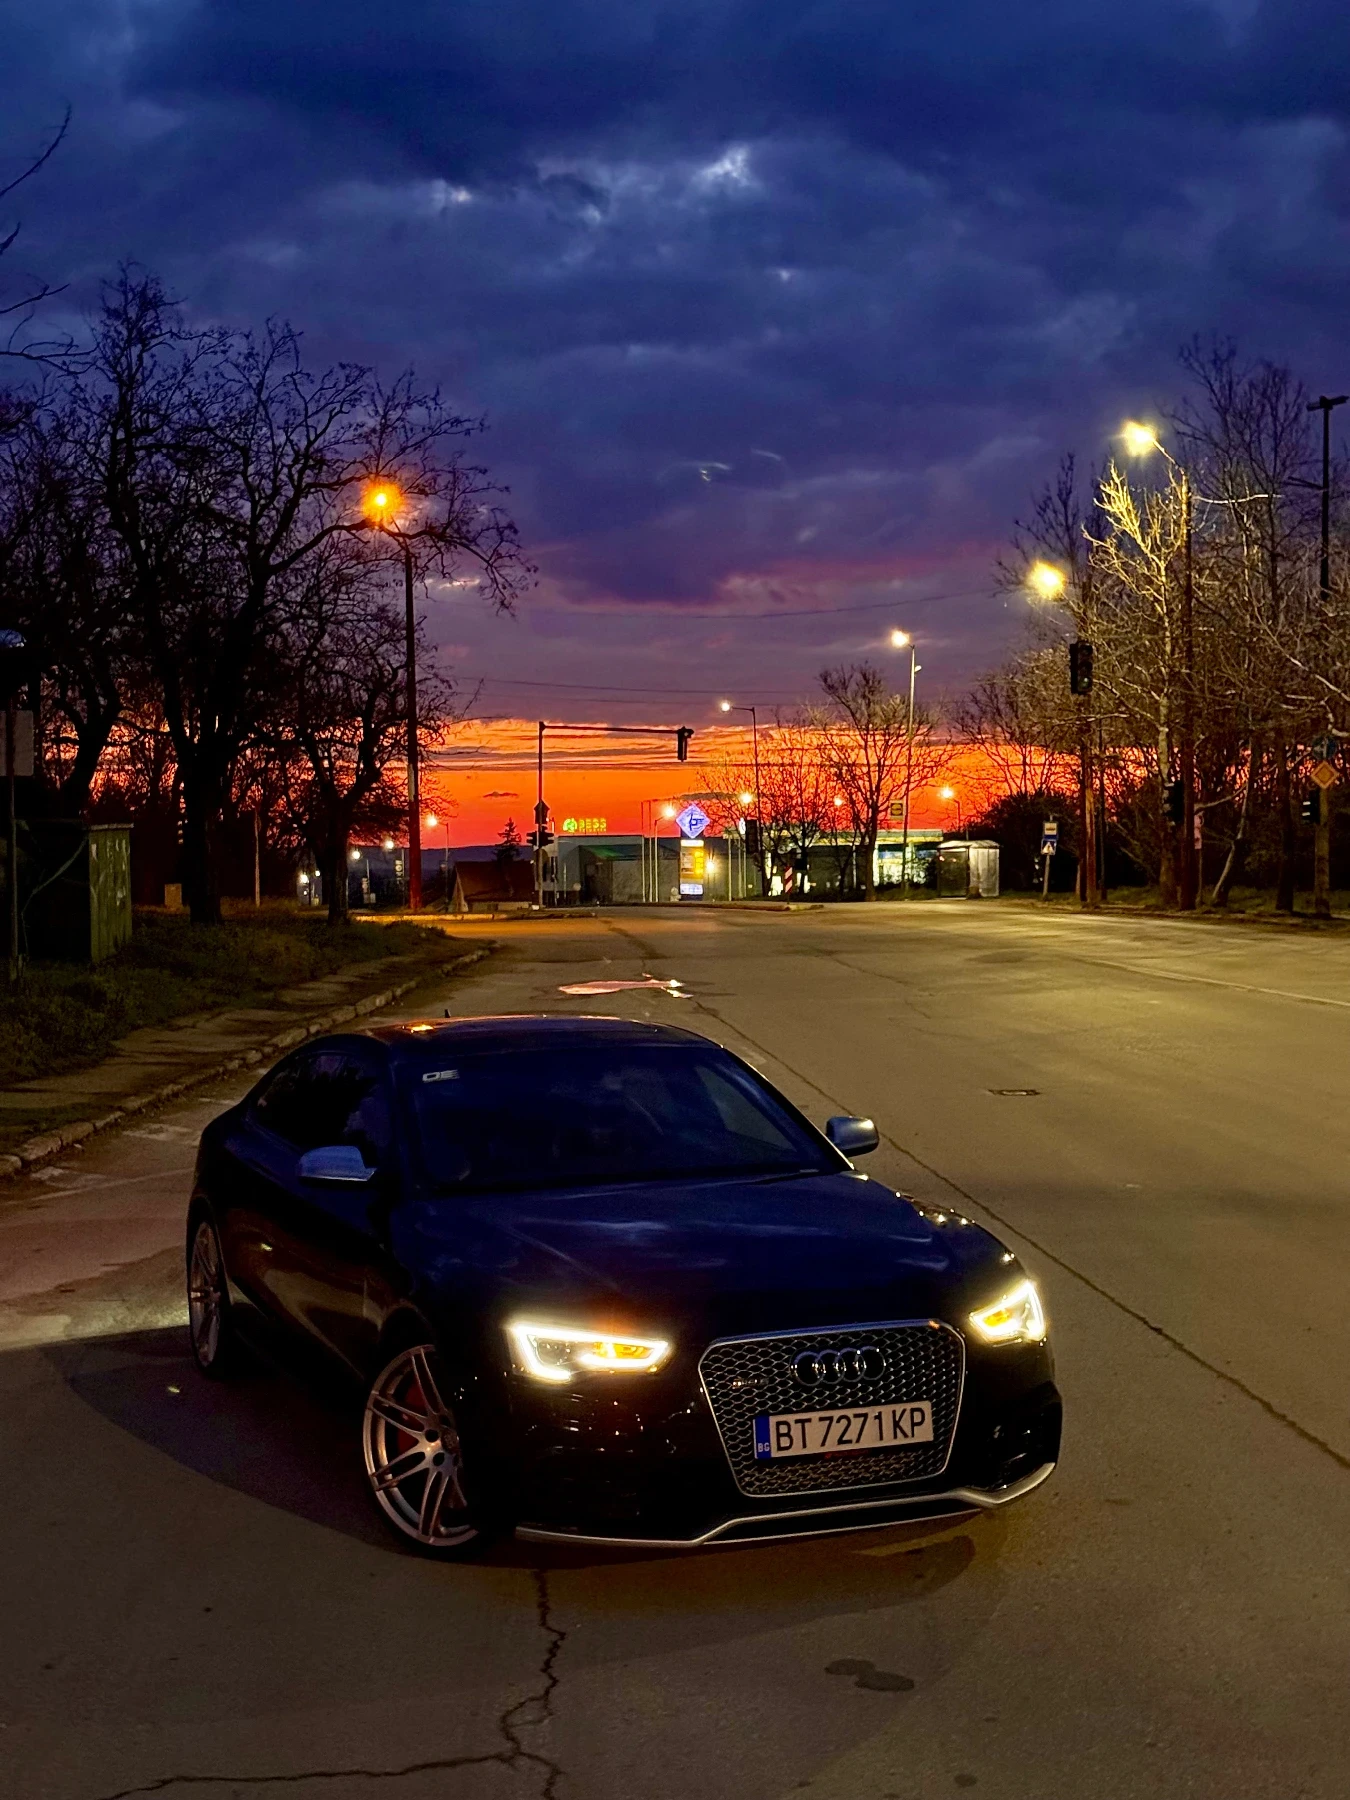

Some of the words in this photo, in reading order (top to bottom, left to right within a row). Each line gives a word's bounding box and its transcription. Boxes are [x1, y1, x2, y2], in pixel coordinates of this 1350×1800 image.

[776, 1419, 812, 1451] BT
[819, 1411, 883, 1446] 7271
[892, 1407, 926, 1439] KP
[758, 1442, 770, 1452] BG
